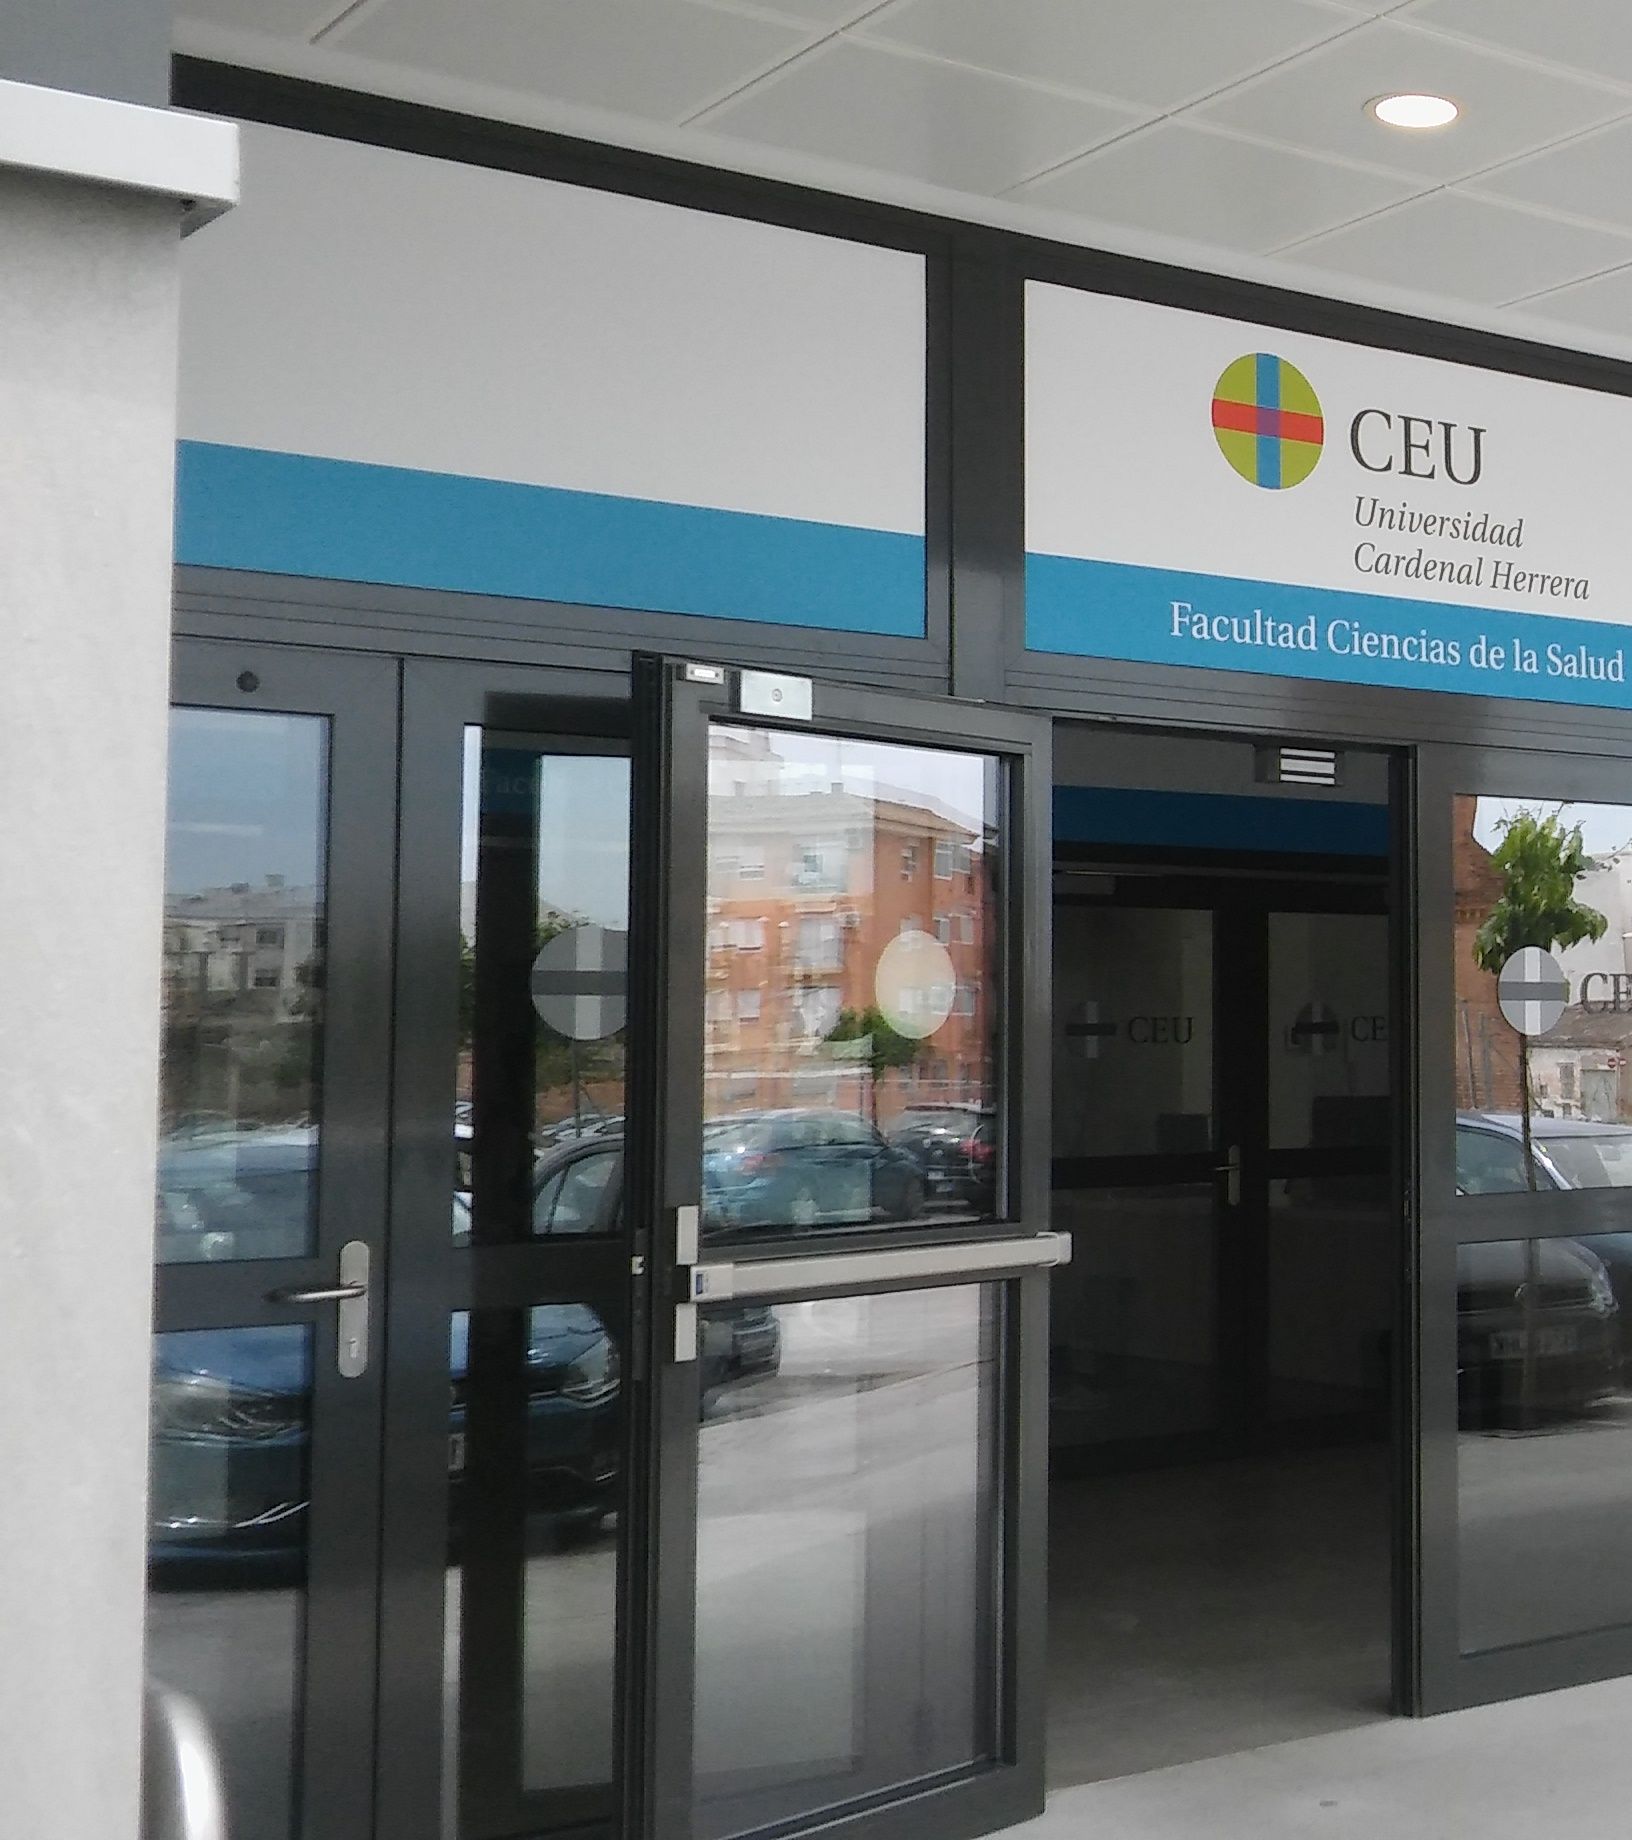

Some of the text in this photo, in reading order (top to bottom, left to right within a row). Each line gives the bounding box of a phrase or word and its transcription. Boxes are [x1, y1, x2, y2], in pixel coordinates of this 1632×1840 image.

[1350, 408, 1487, 486] CEU
[1354, 495, 1524, 549] Universidad
[1354, 543, 1590, 600] Cardenal Herrera
[1170, 600, 1625, 682] Facultad Ciencias de la Salud
[1128, 1016, 1194, 1044] CEU
[1351, 1015, 1388, 1042] CE
